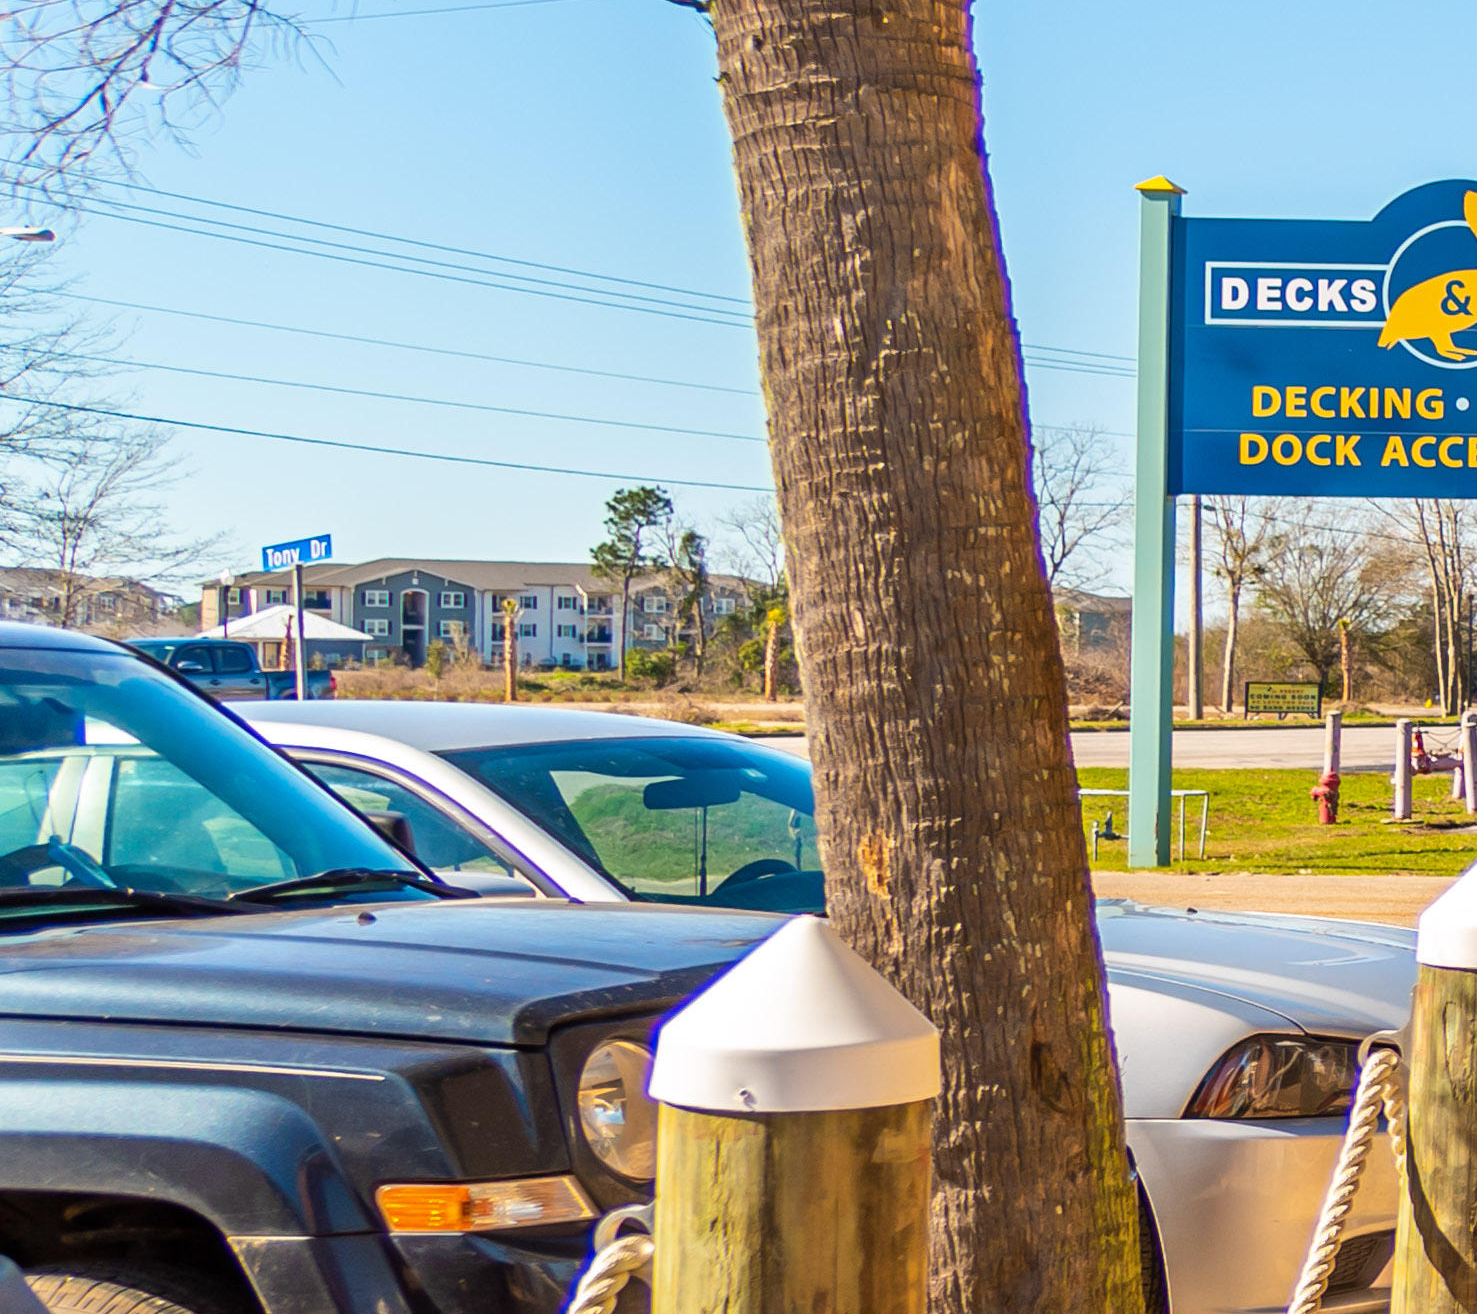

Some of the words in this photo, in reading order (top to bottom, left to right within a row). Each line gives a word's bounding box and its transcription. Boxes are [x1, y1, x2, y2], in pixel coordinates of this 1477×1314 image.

[1221, 277, 1377, 313] DECKS
[1440, 279, 1473, 316] &
[1252, 385, 1445, 420] DECKING
[1239, 432, 1362, 466] DOCK
[266, 547, 300, 568] Tony
[310, 539, 328, 559] Dr
